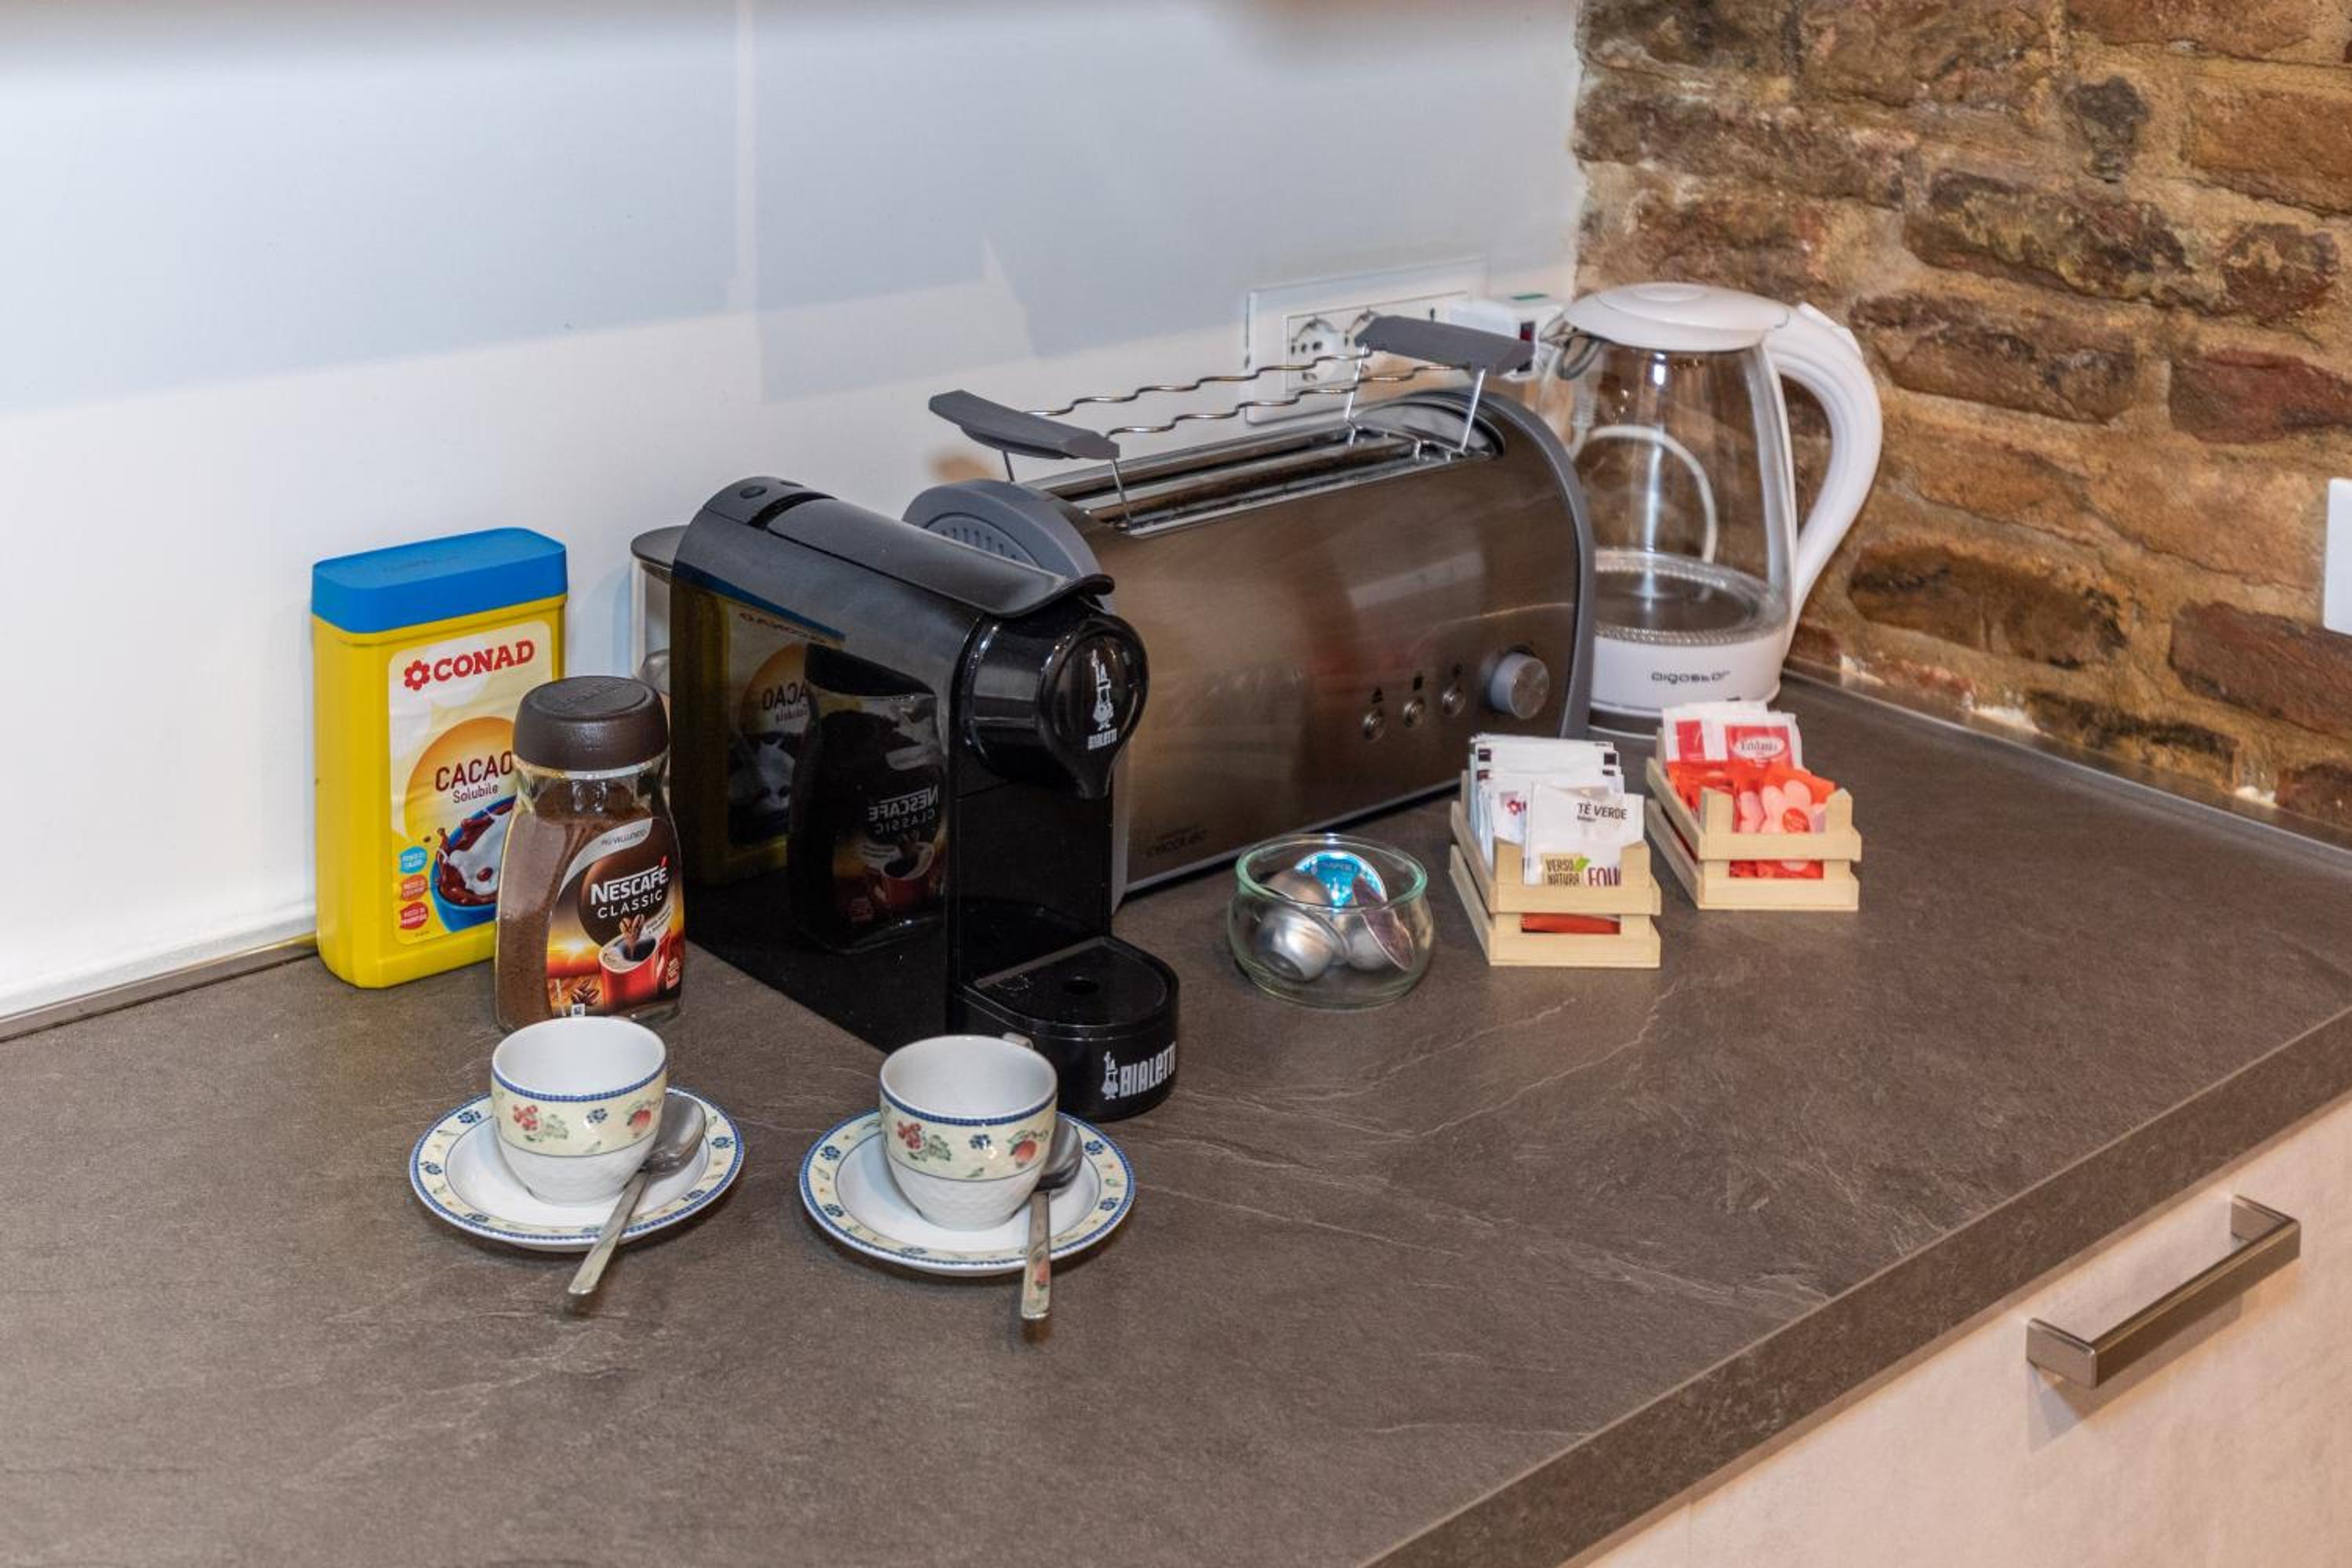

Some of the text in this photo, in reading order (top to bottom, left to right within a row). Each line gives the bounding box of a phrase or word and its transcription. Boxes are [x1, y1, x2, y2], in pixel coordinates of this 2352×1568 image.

[434, 639, 535, 681] CONAD
[435, 750, 513, 791] CACAO
[453, 782, 498, 803] Solubile
[1594, 804, 1628, 820] VERDE
[1545, 858, 1574, 873] VERSO
[590, 855, 669, 906] NESCAFÉ
[1547, 873, 1580, 885] NATURA
[597, 890, 662, 918] CLASSIC
